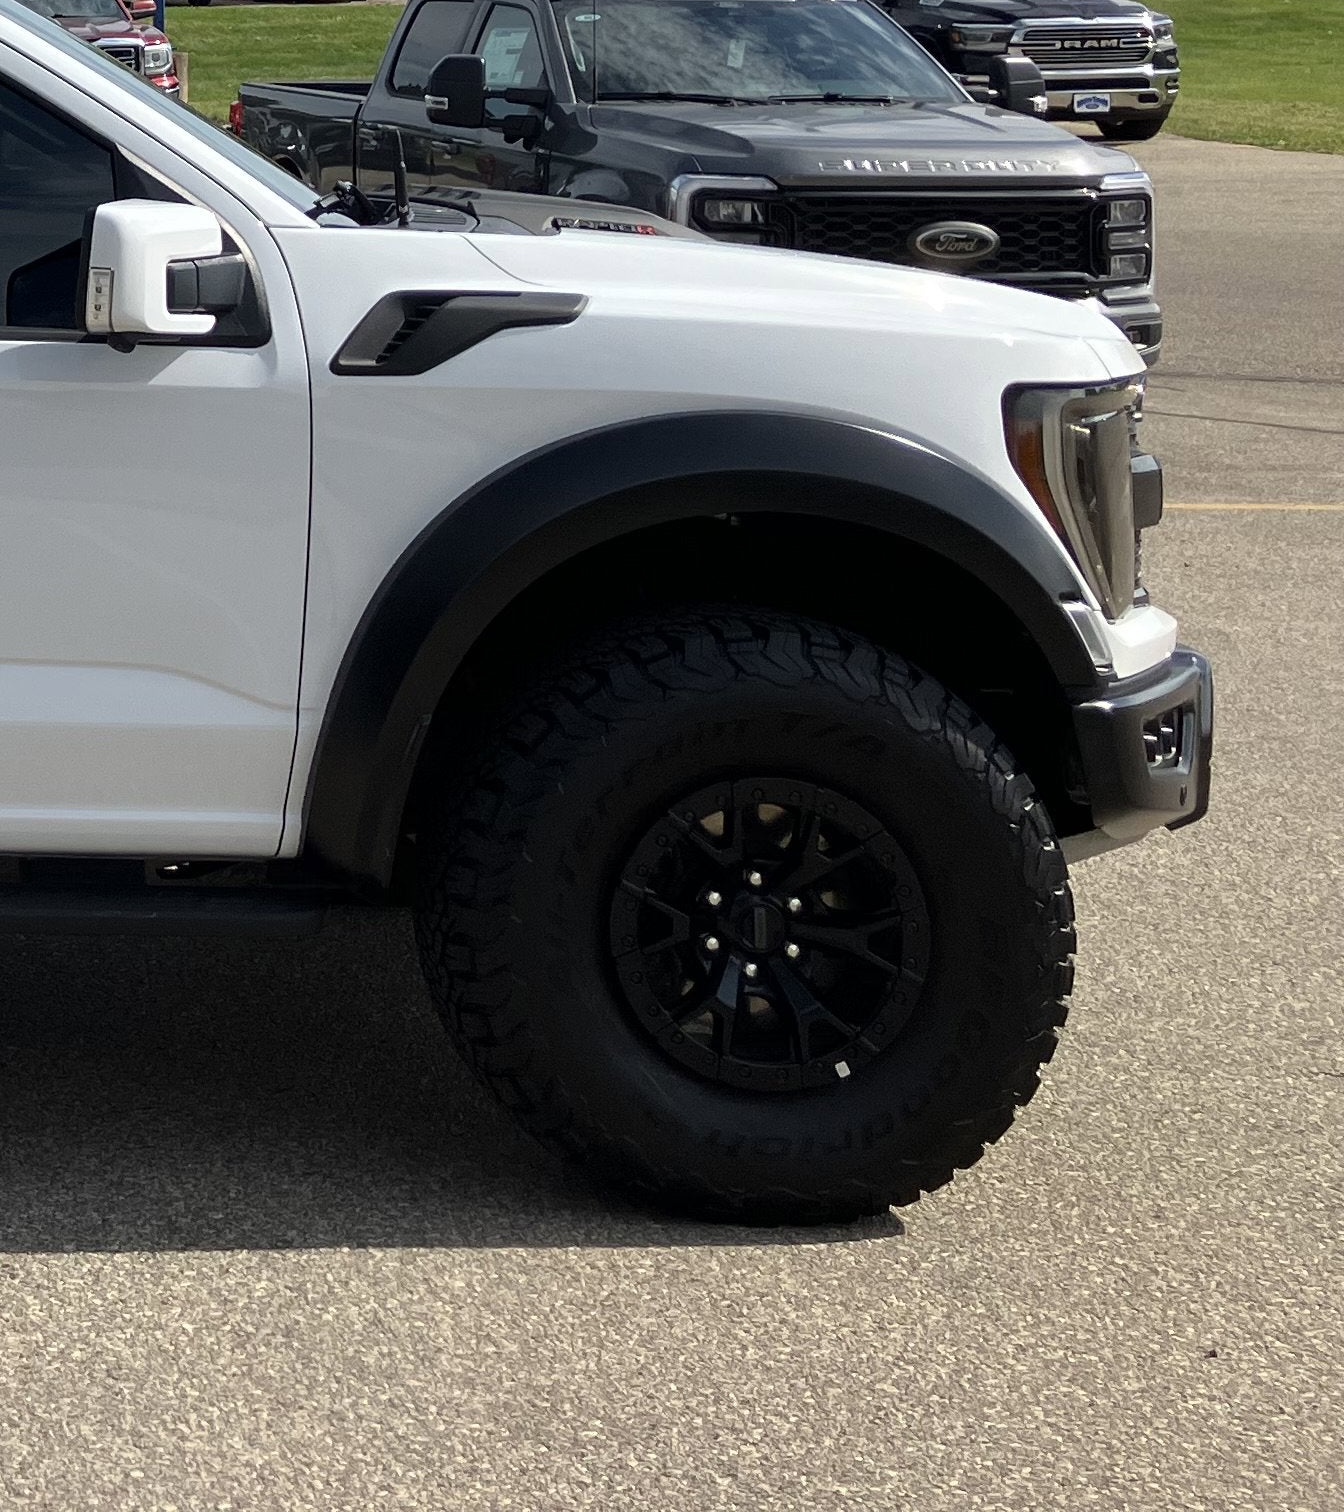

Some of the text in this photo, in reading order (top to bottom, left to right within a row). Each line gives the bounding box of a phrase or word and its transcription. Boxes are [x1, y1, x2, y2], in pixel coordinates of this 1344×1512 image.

[1062, 38, 1119, 49] RAM
[817, 159, 1061, 173] SUPER DUTY
[934, 232, 979, 253] Ford
